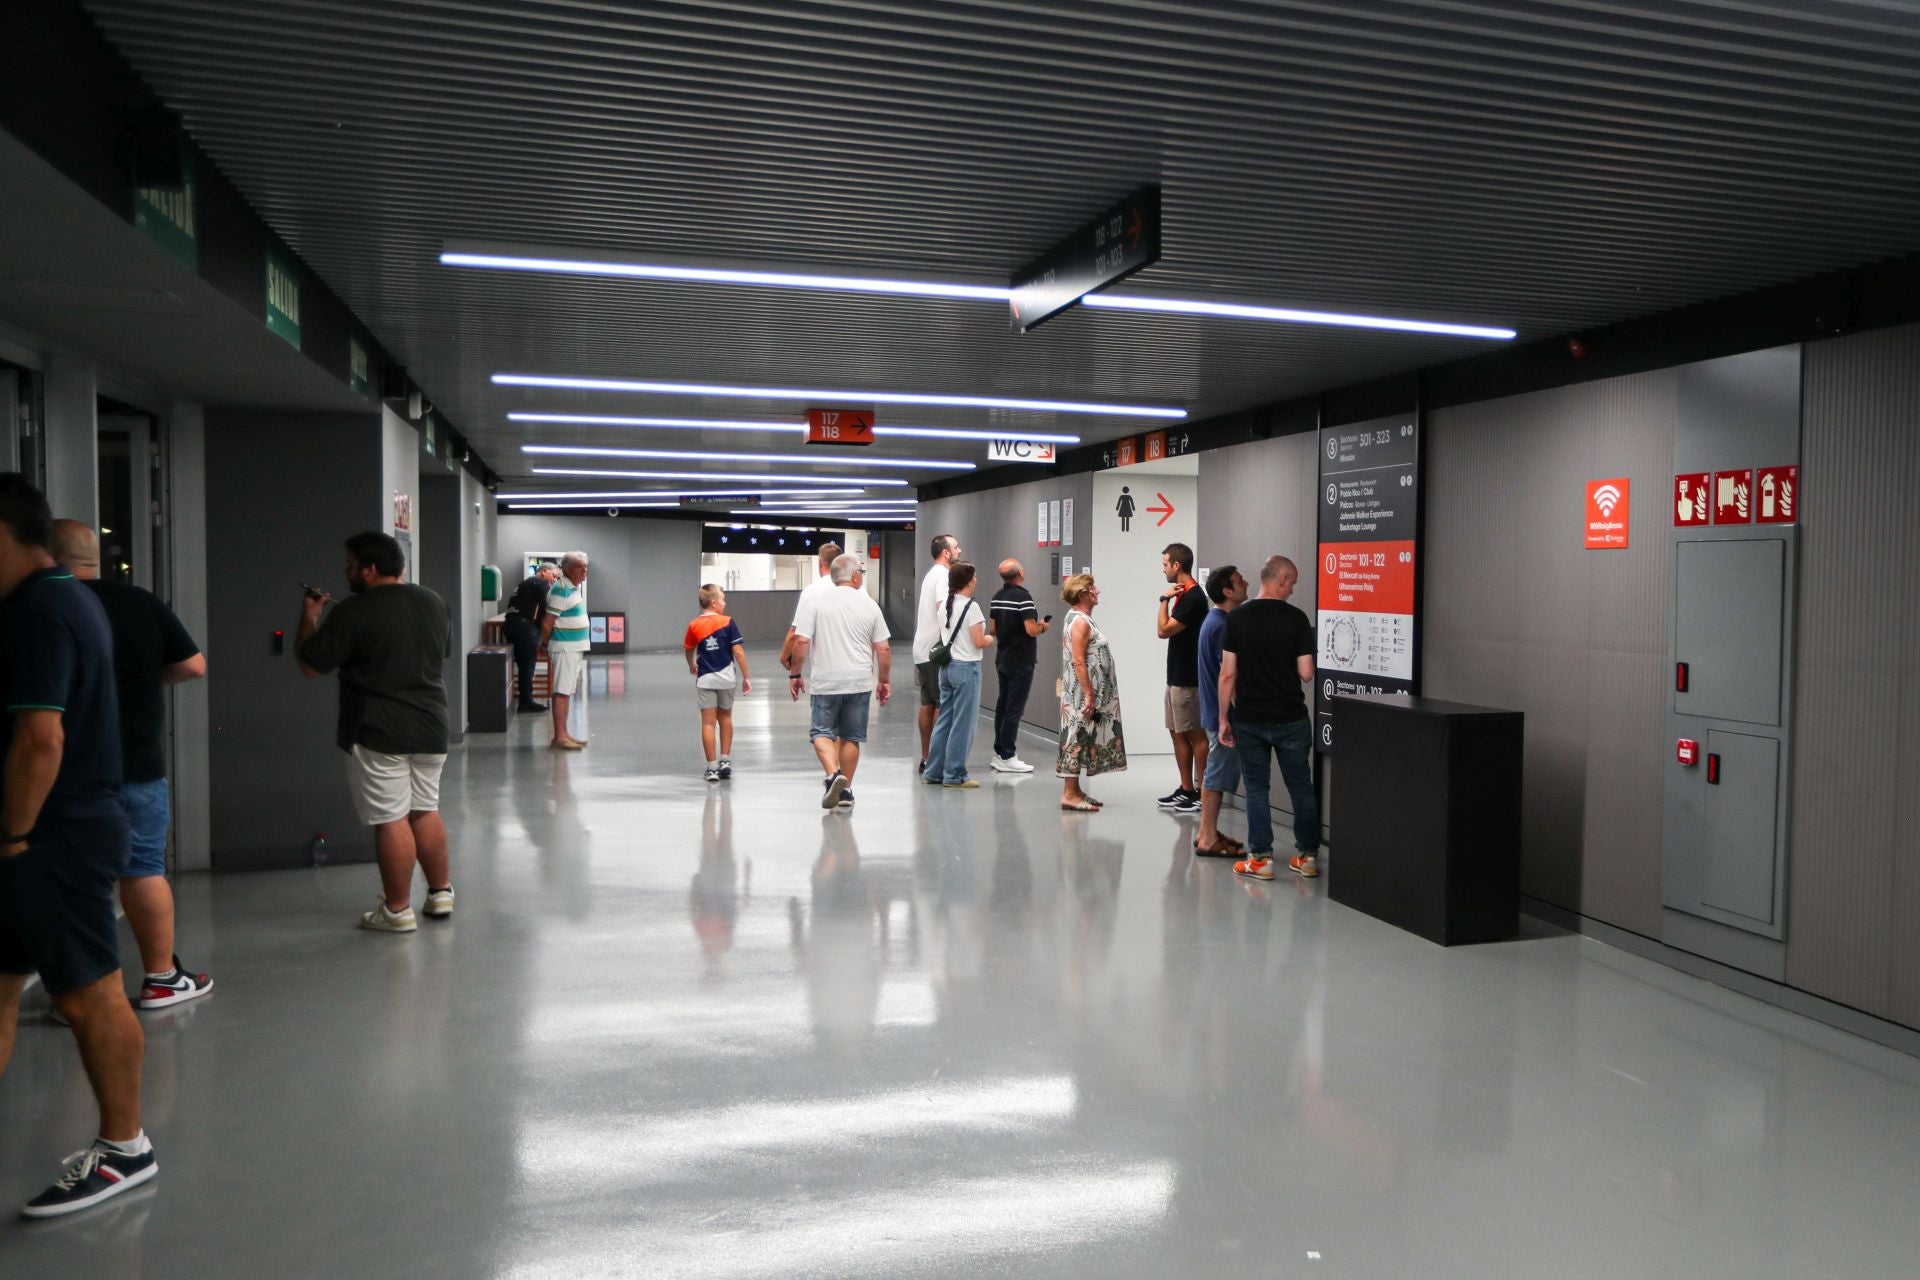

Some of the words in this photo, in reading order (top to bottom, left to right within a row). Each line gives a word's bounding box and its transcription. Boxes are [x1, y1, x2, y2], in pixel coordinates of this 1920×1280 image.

[822, 412, 840, 424] 117
[821, 426, 840, 438] 118
[1360, 433, 1371, 447] 301
[1376, 430, 1390, 444] 323
[994, 440, 1032, 458] WC
[1122, 446, 1130, 464] 117
[1150, 440, 1160, 457] 118
[1370, 510, 1394, 519] Experience
[1340, 523, 1360, 532] Backstage
[1362, 523, 1376, 532] Lounge
[1359, 554, 1368, 567] 101
[1374, 554, 1385, 566] 122
[1364, 584, 1373, 592] Roig
[1337, 680, 1354, 689] Sectores
[1356, 684, 1366, 695] 101
